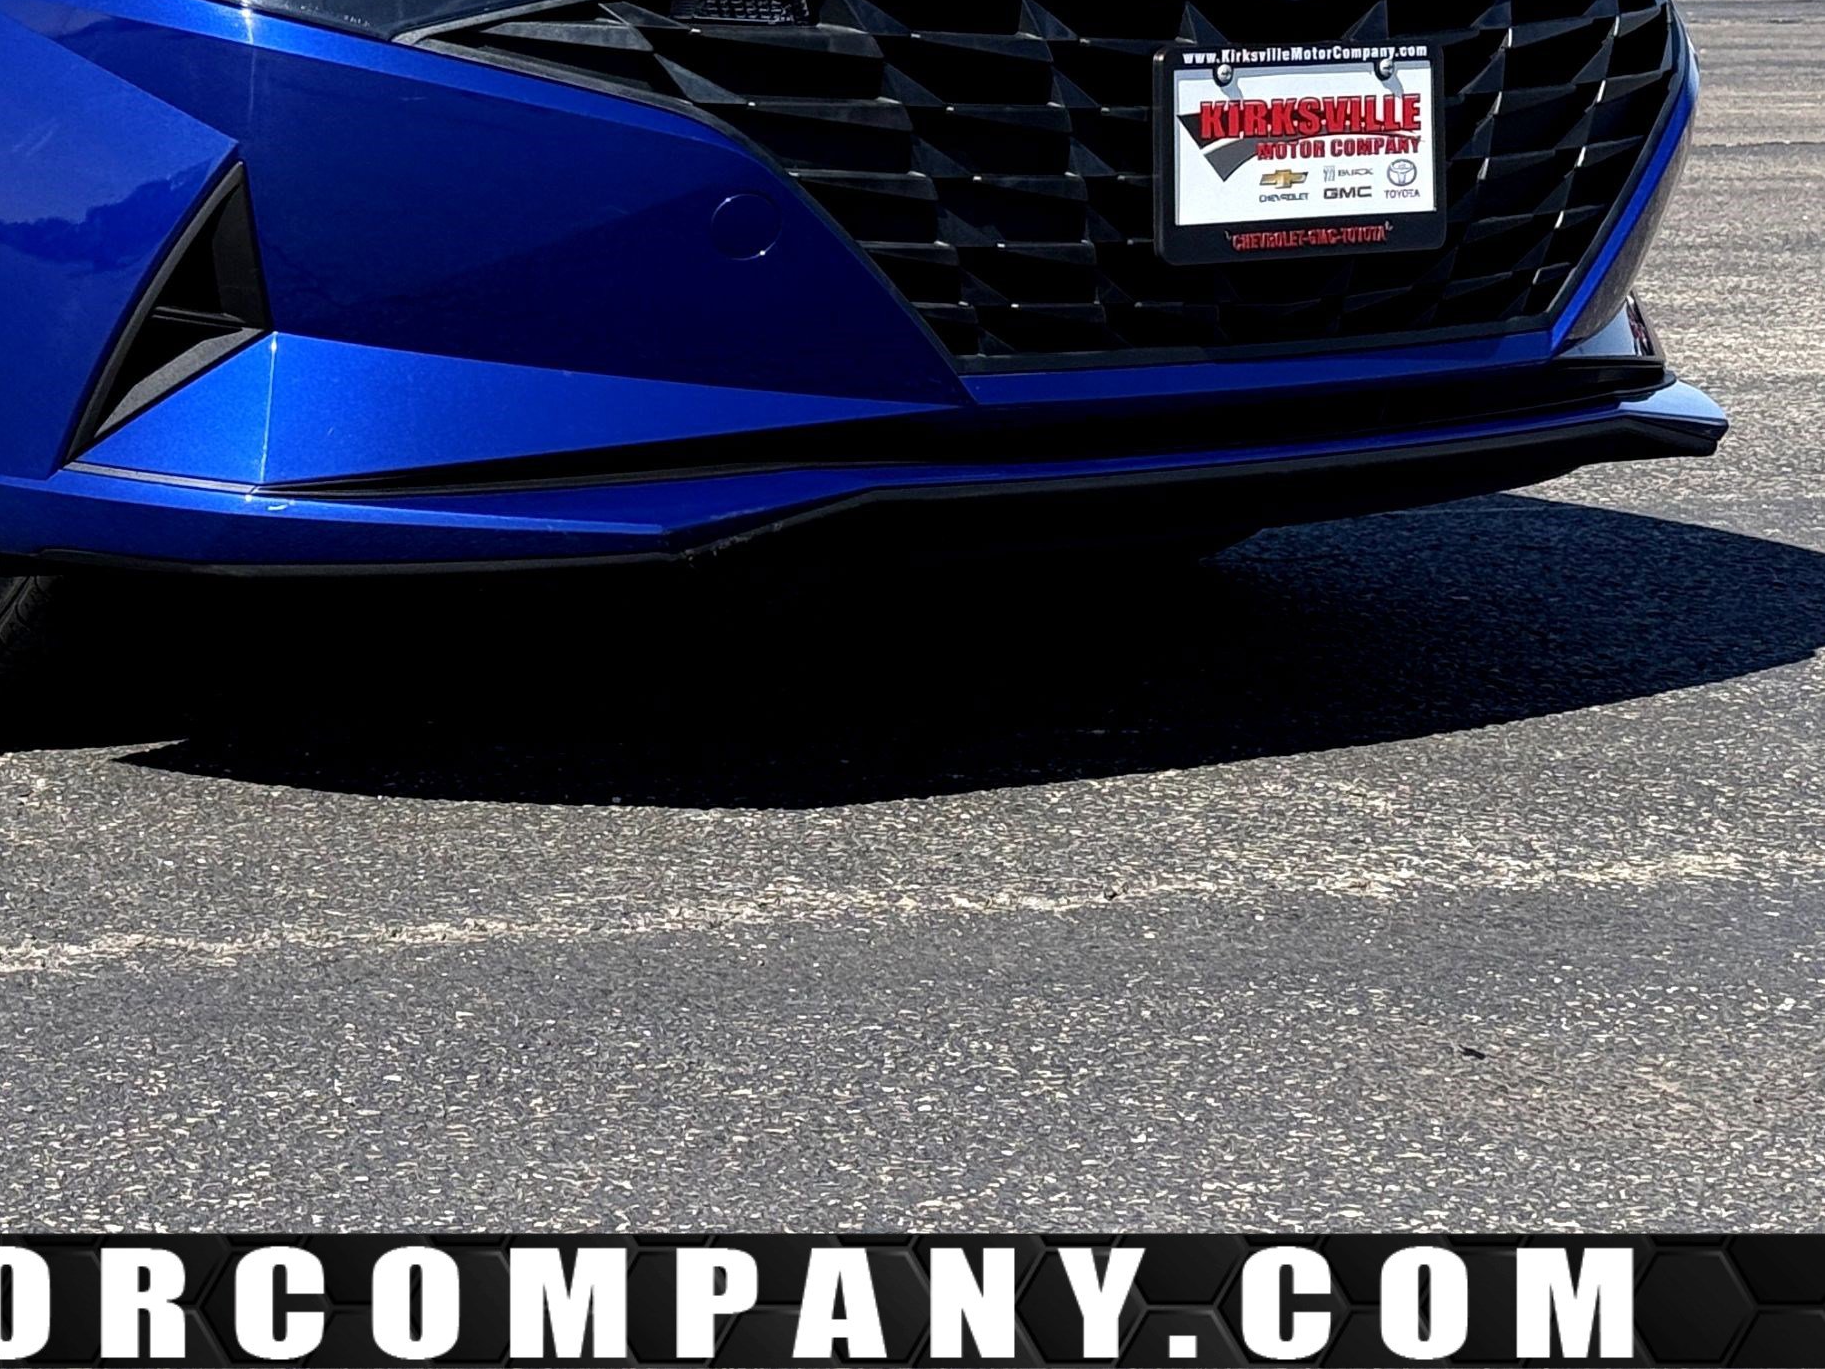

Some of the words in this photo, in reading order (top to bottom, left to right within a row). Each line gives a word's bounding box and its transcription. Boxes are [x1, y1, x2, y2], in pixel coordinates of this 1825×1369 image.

[1182, 45, 1428, 64] www.KirksvilleMotorCompany.com
[1198, 93, 1422, 139] KIRKSVILLE
[1256, 140, 1326, 161] MOTOR
[1330, 135, 1423, 157] COMPANY
[1259, 192, 1309, 203] CHEVROLET
[1323, 185, 1373, 200] GMC
[1384, 188, 1421, 200] TOYOTA
